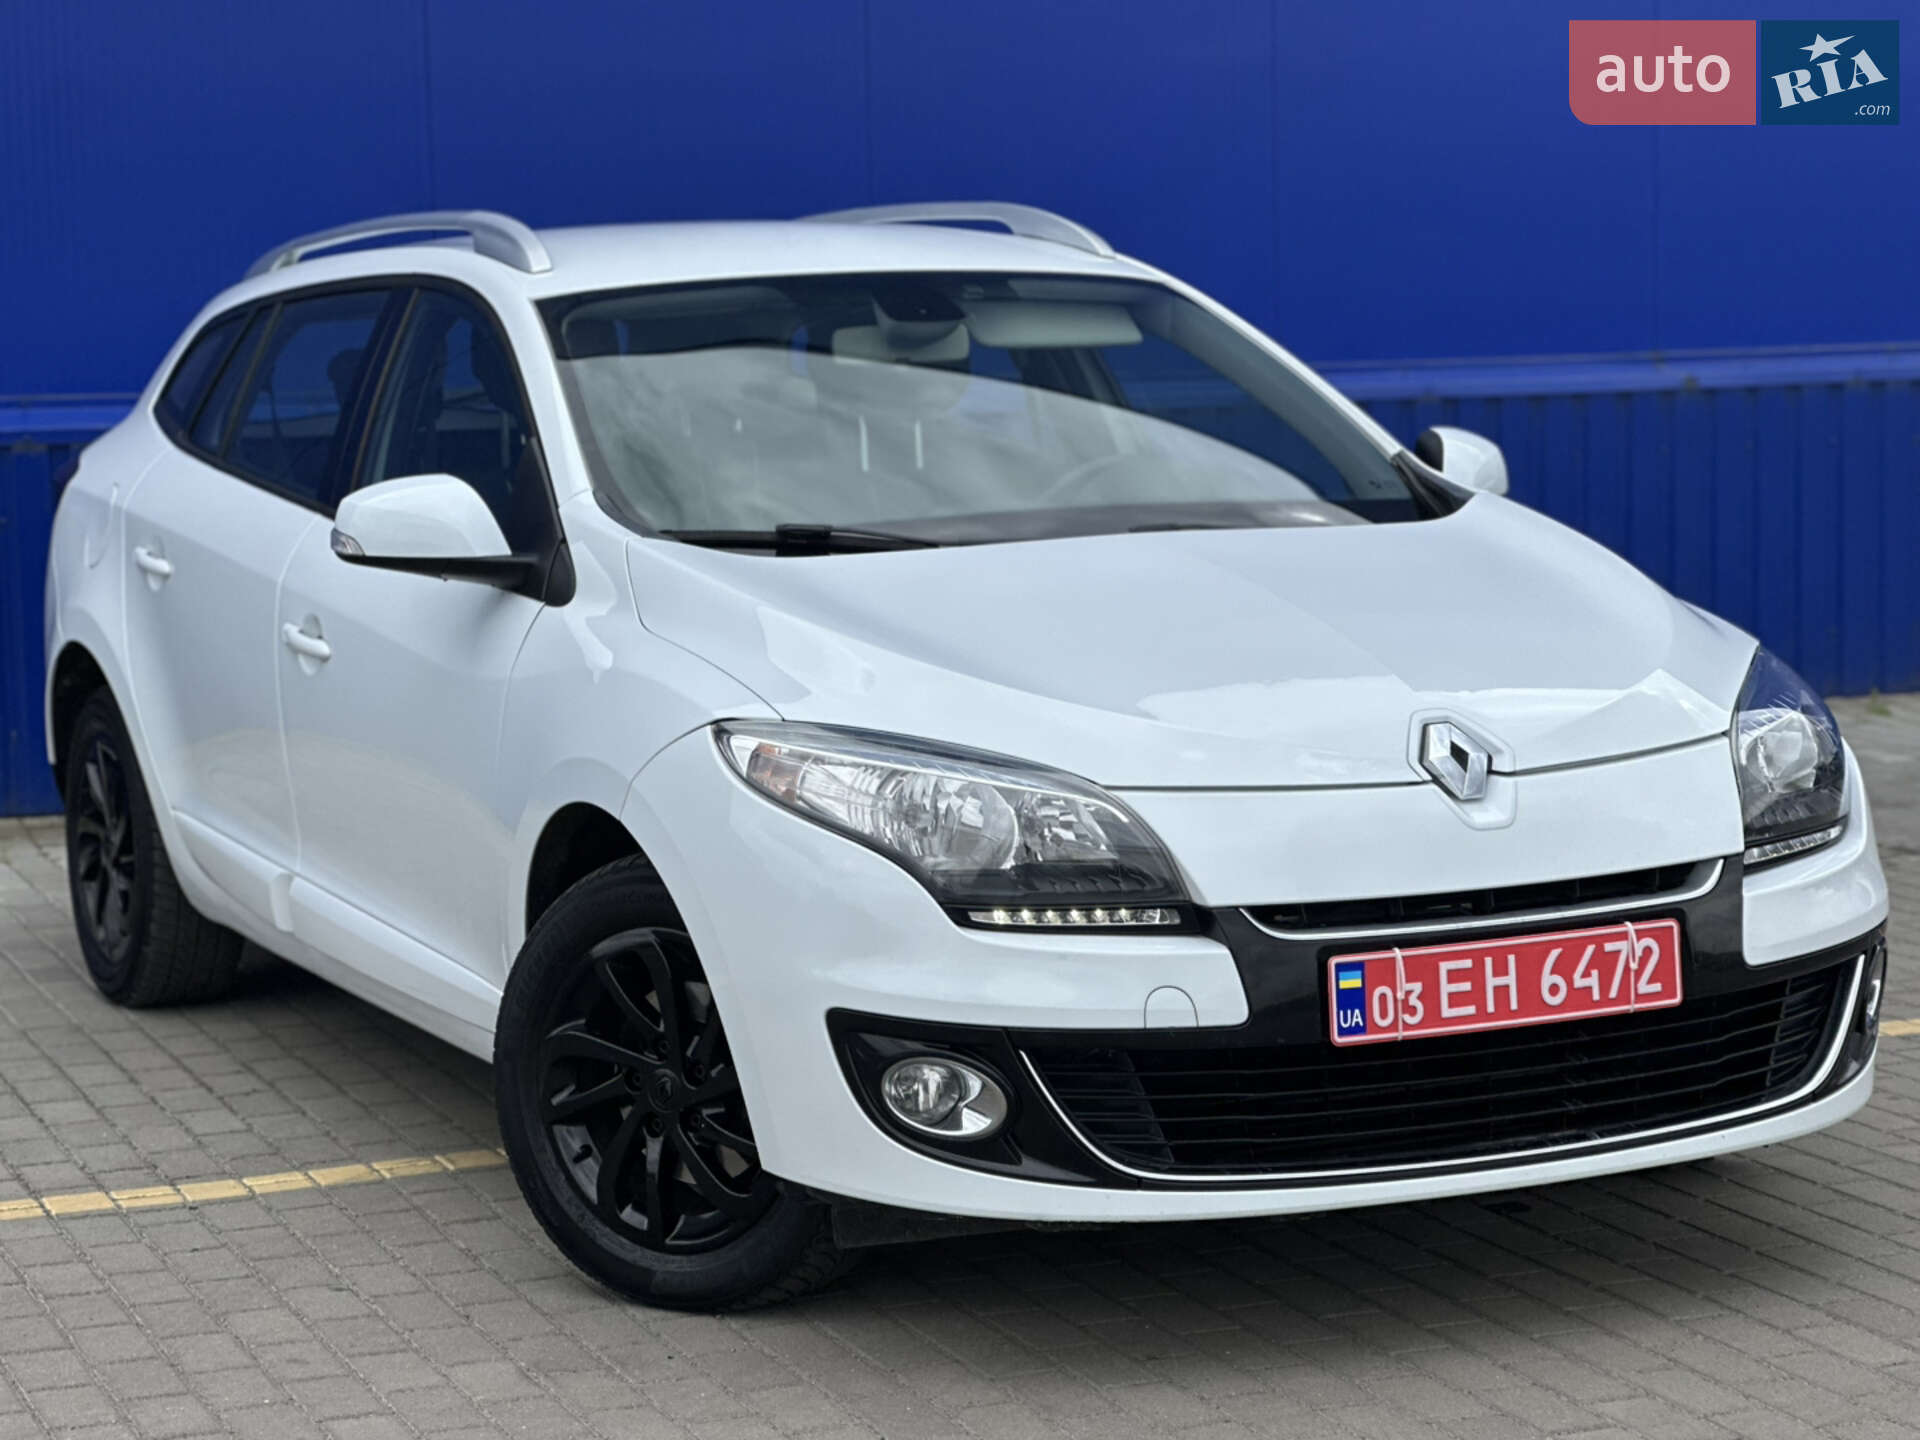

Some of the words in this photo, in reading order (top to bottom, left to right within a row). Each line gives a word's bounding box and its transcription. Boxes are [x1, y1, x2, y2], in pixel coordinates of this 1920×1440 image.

[1372, 983, 1425, 1028] 03
[1438, 954, 1519, 1019] EH
[1540, 937, 1662, 1007] 6472
[1339, 1008, 1364, 1028] UA
